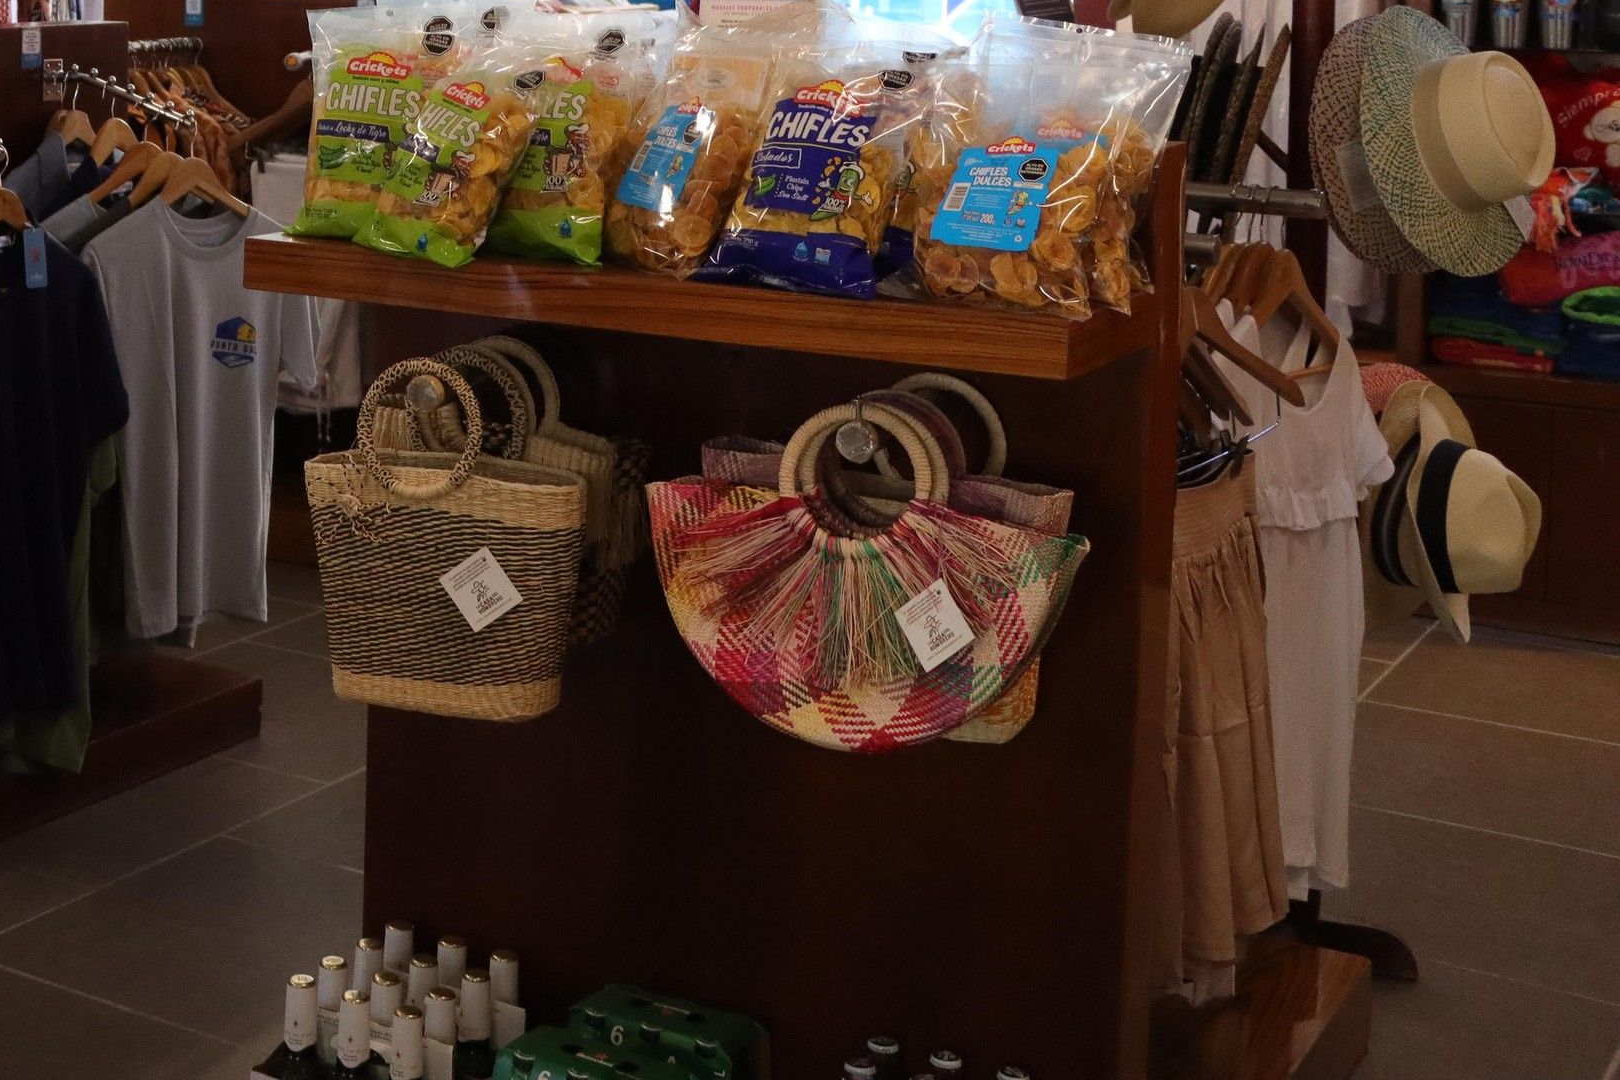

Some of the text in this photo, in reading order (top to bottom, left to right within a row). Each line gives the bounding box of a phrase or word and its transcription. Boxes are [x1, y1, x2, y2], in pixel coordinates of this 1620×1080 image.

[325, 81, 421, 119] CHIFLES
[765, 111, 870, 147] CHIFLES
[969, 166, 1008, 176] CHIFLES
[973, 176, 1012, 187] DULCES
[610, 1025, 624, 1047] 6
